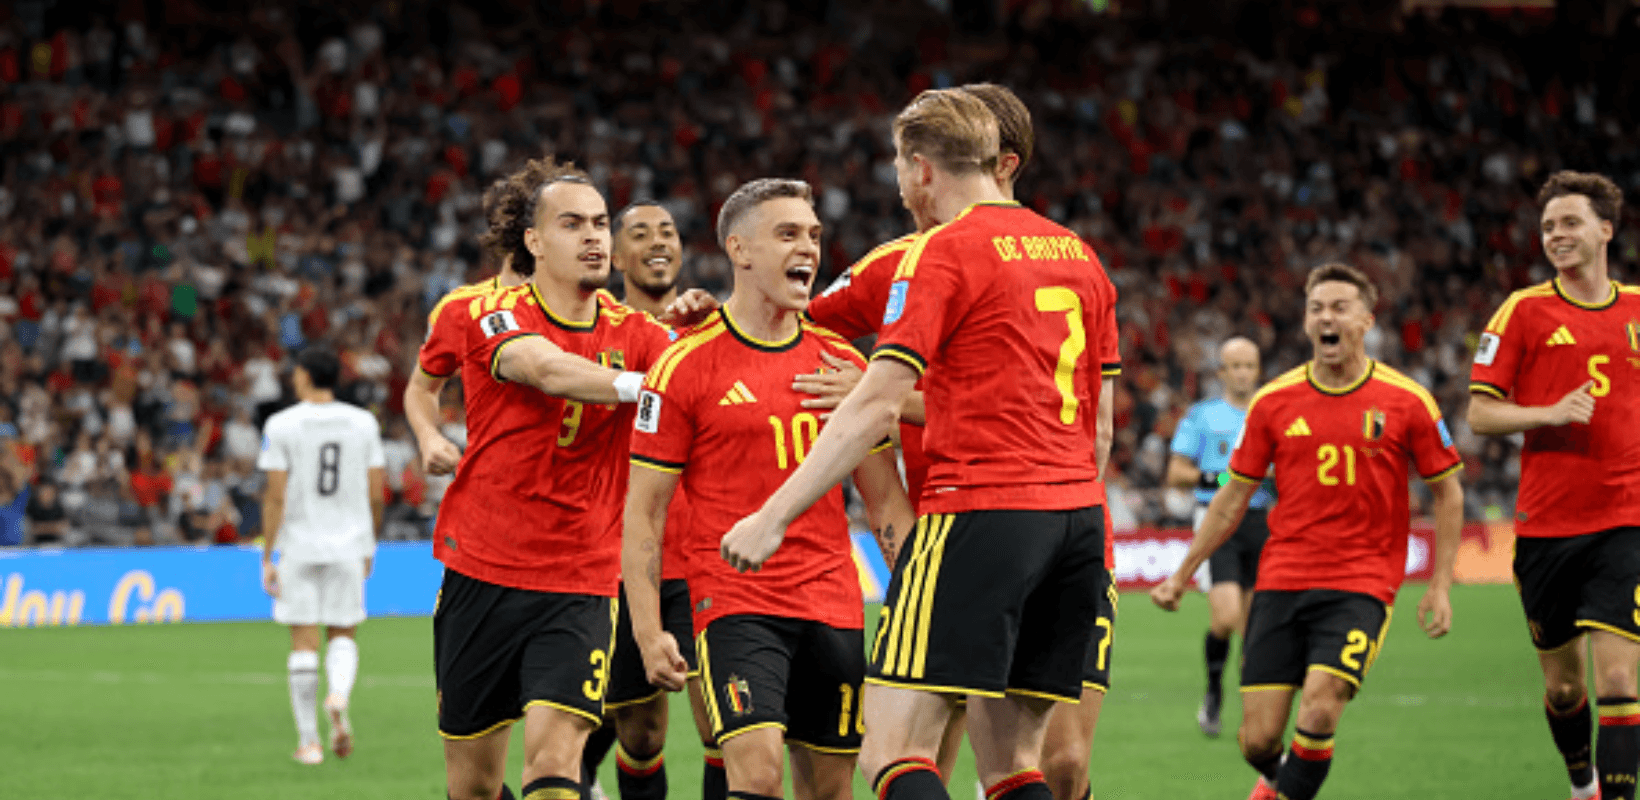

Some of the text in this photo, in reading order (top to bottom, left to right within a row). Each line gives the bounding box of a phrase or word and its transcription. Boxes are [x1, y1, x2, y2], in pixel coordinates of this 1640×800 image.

[992, 236, 1022, 262] DE
[1035, 286, 1086, 425] 7
[1587, 354, 1611, 397] 5
[557, 400, 583, 447] 3
[768, 412, 819, 470] 10
[317, 441, 341, 498] 8
[1316, 443, 1356, 486] 21
[1095, 616, 1112, 671] 7
[581, 649, 607, 701] 3
